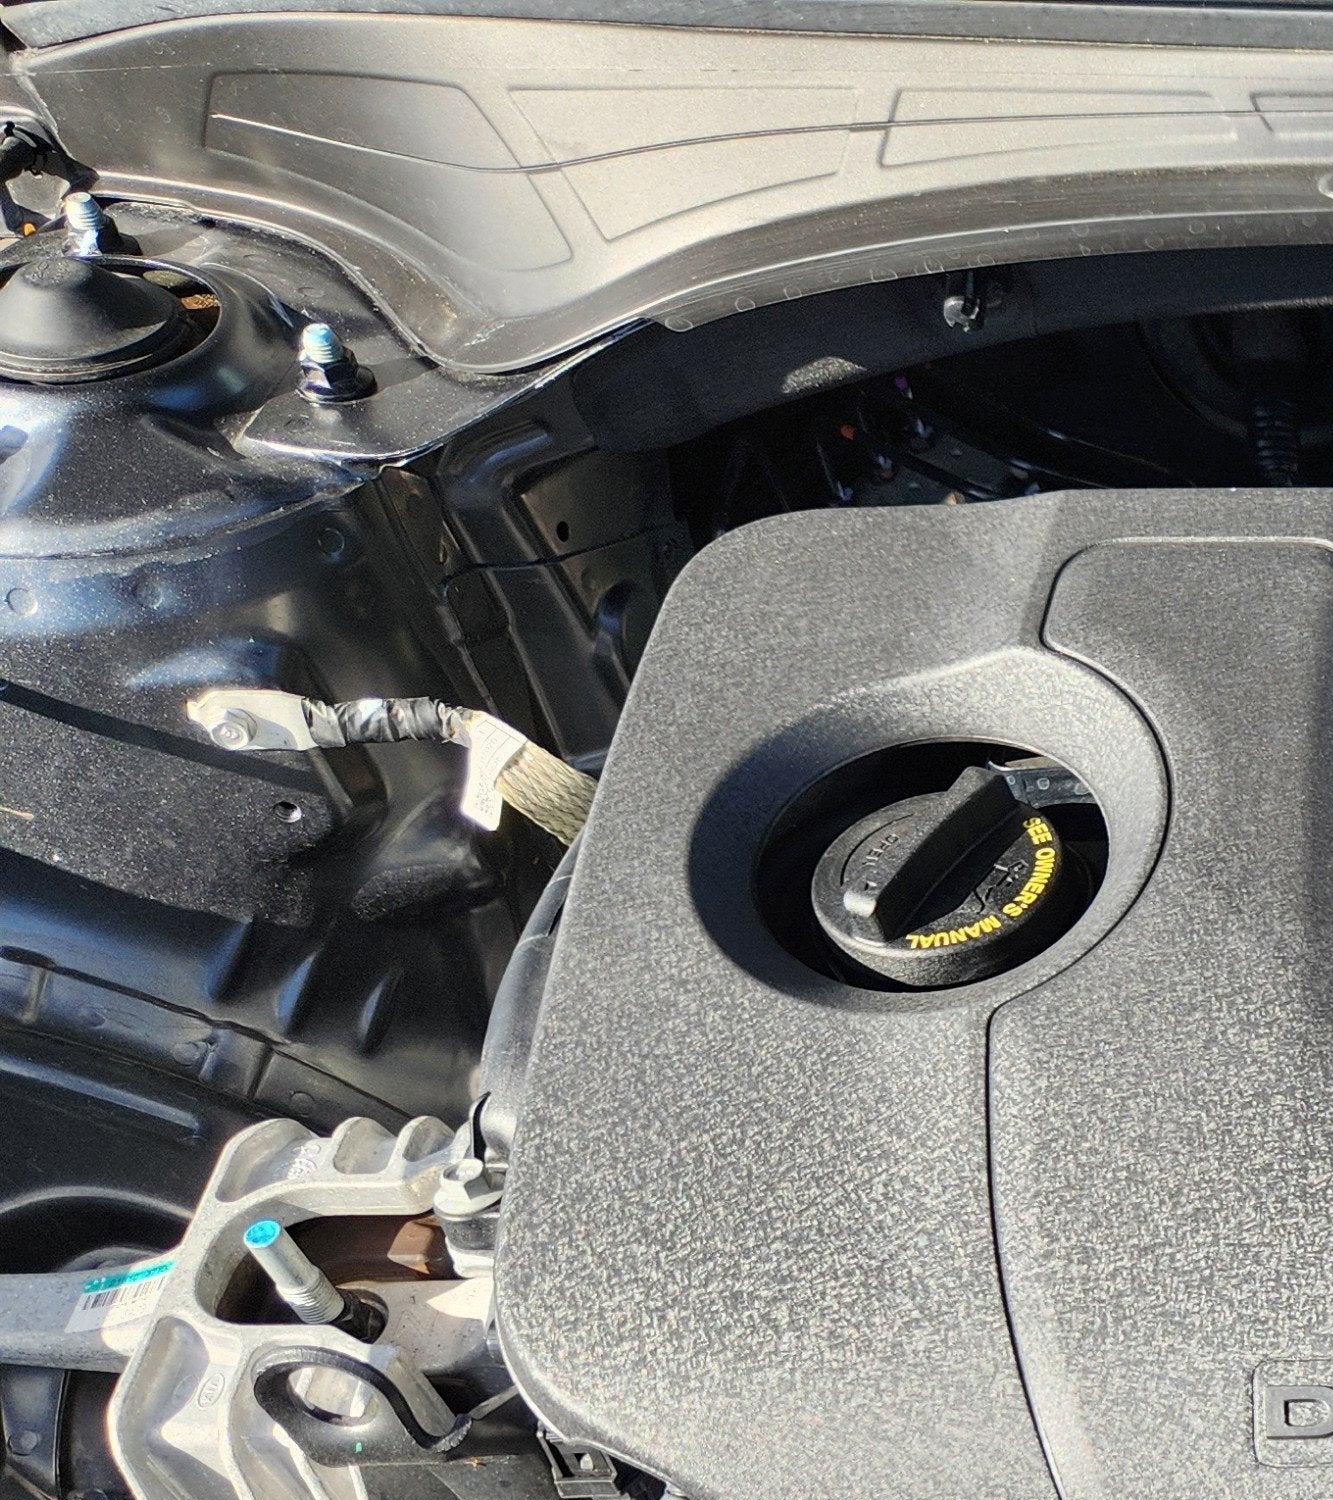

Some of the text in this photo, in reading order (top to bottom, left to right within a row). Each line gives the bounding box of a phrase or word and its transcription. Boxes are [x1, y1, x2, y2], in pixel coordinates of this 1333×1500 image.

[905, 816, 1057, 950] SEE OWNER'S MANUAL
